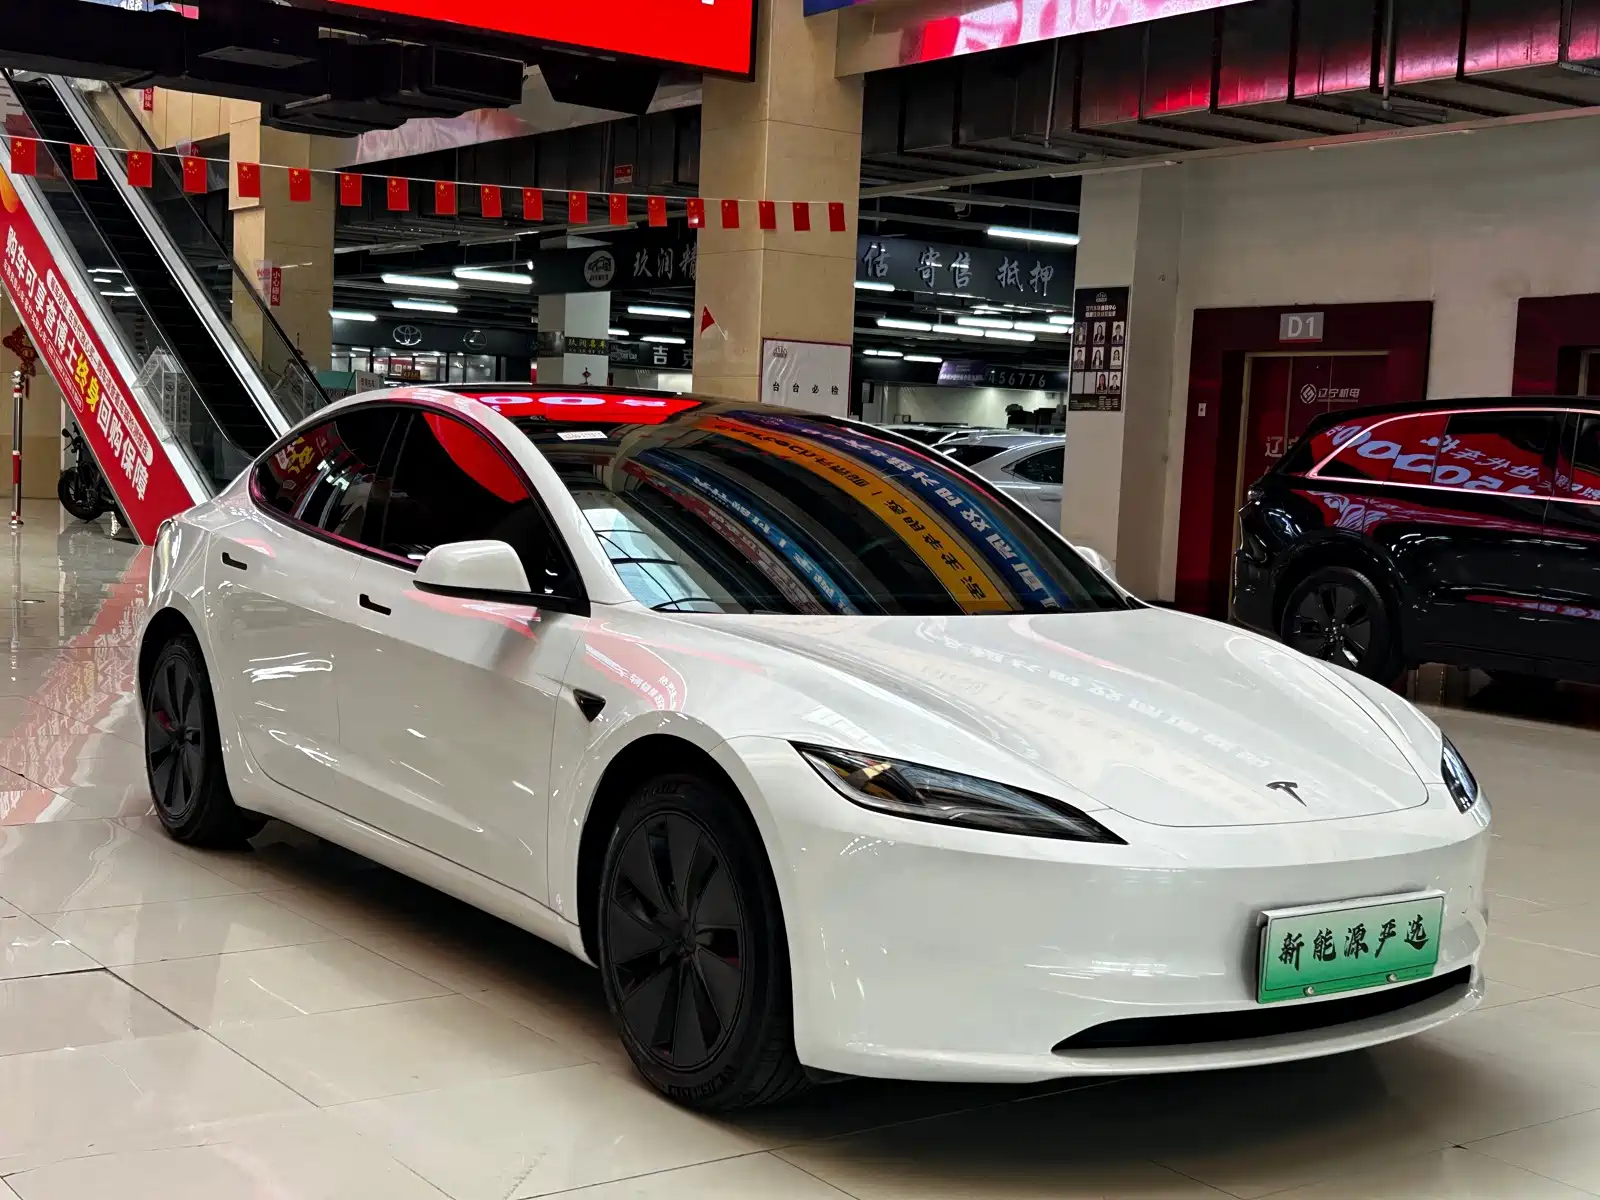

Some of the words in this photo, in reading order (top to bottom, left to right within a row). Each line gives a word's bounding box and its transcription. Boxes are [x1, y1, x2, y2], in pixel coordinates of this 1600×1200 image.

[997, 256, 1054, 297] 抵押
[1287, 316, 1315, 338] D1
[5, 225, 149, 501] 购车可享查博士终身回购保障
[773, 381, 840, 396] 台台必检
[1277, 914, 1430, 972] 新能源严选
